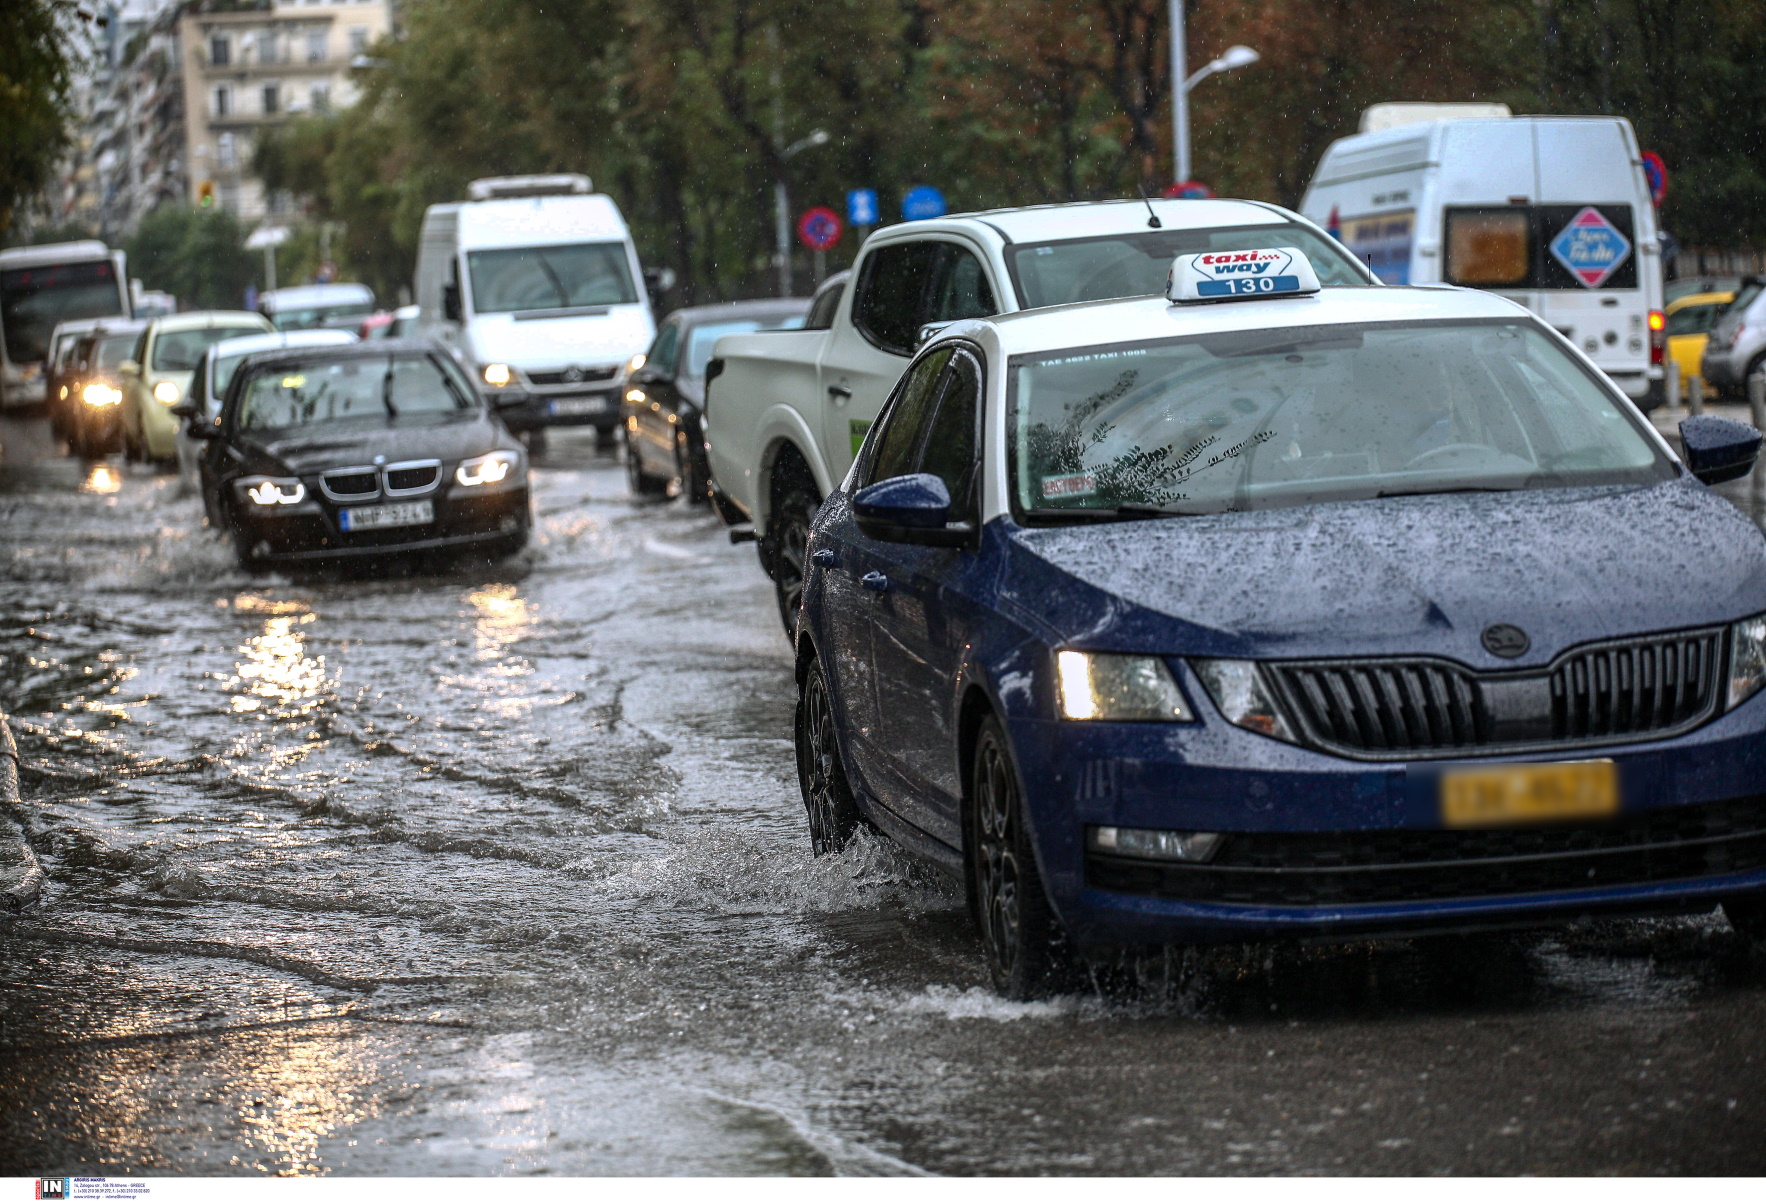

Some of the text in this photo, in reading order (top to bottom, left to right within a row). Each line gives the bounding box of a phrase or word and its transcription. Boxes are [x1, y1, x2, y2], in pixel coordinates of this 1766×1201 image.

[1202, 251, 1258, 265] taxi
[1214, 262, 1271, 274] way
[1226, 277, 1275, 294] 130
[1092, 352, 1118, 360] TAXI
